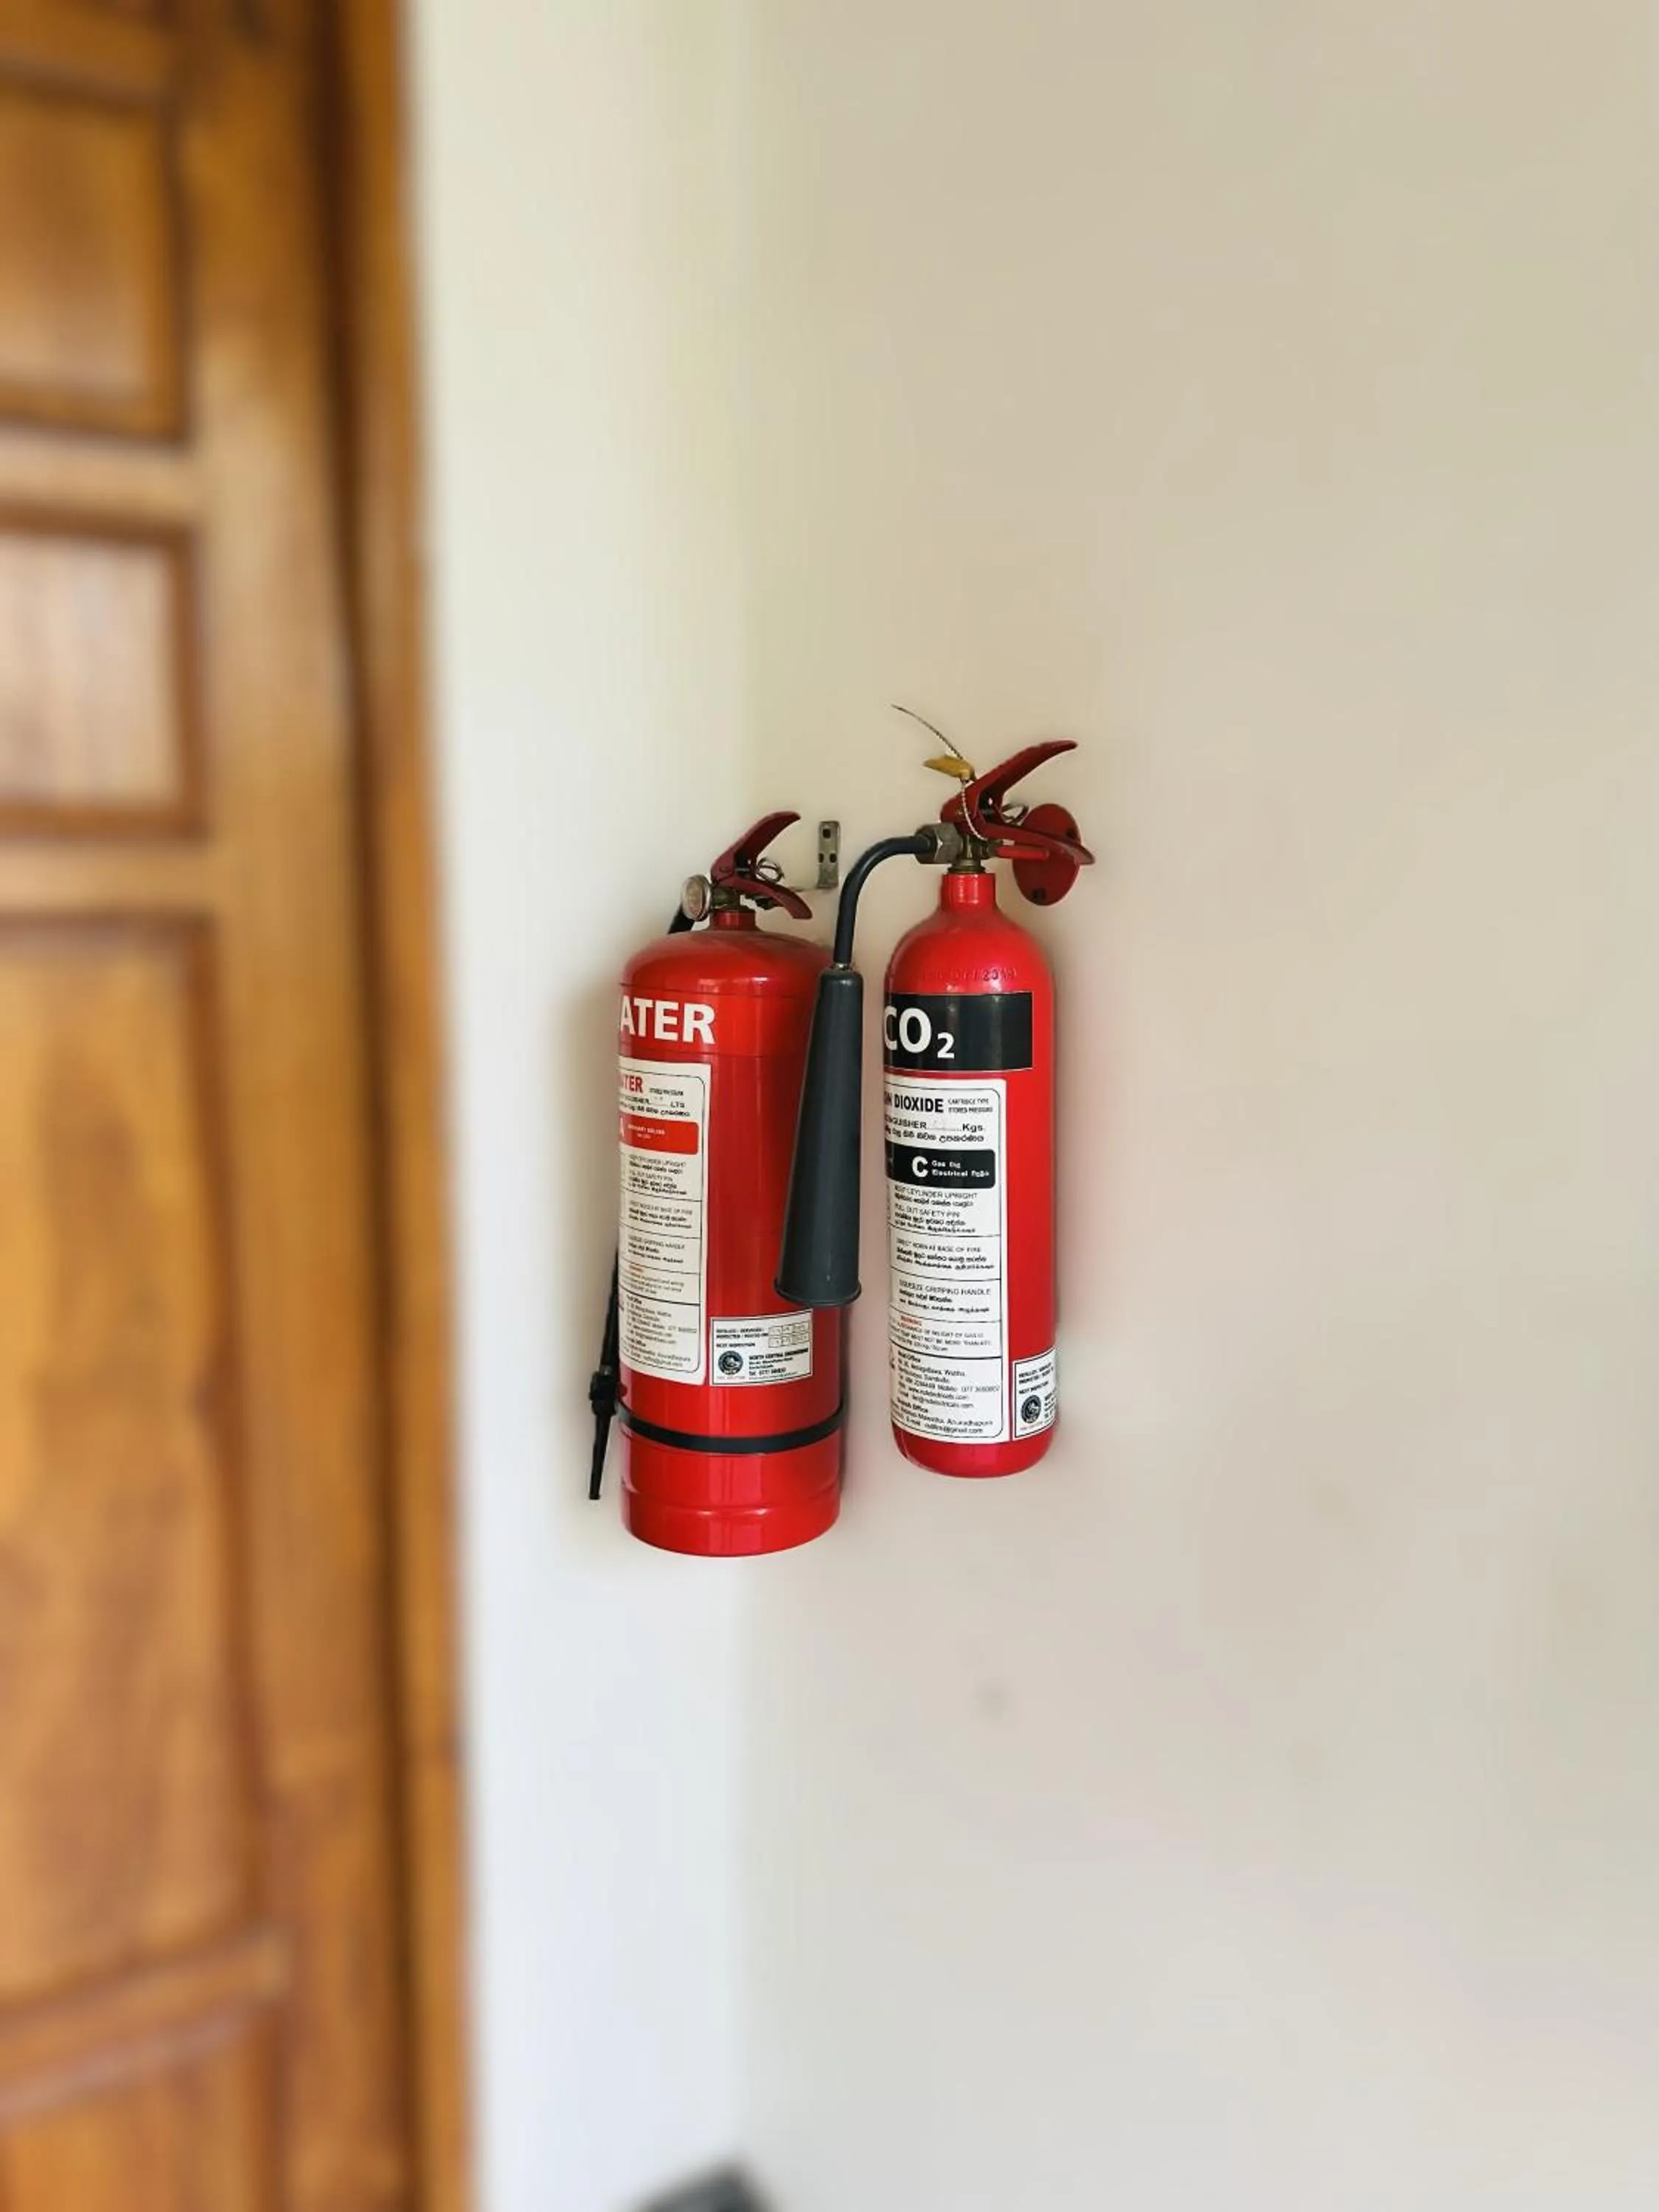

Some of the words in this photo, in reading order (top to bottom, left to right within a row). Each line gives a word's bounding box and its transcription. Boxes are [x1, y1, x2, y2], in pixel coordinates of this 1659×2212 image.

[894, 1093, 944, 1113] DIOXIDE
[912, 1155, 928, 1178] C
[919, 1208, 945, 1217] SAFETY
[961, 1287, 991, 1295] HANDLE
